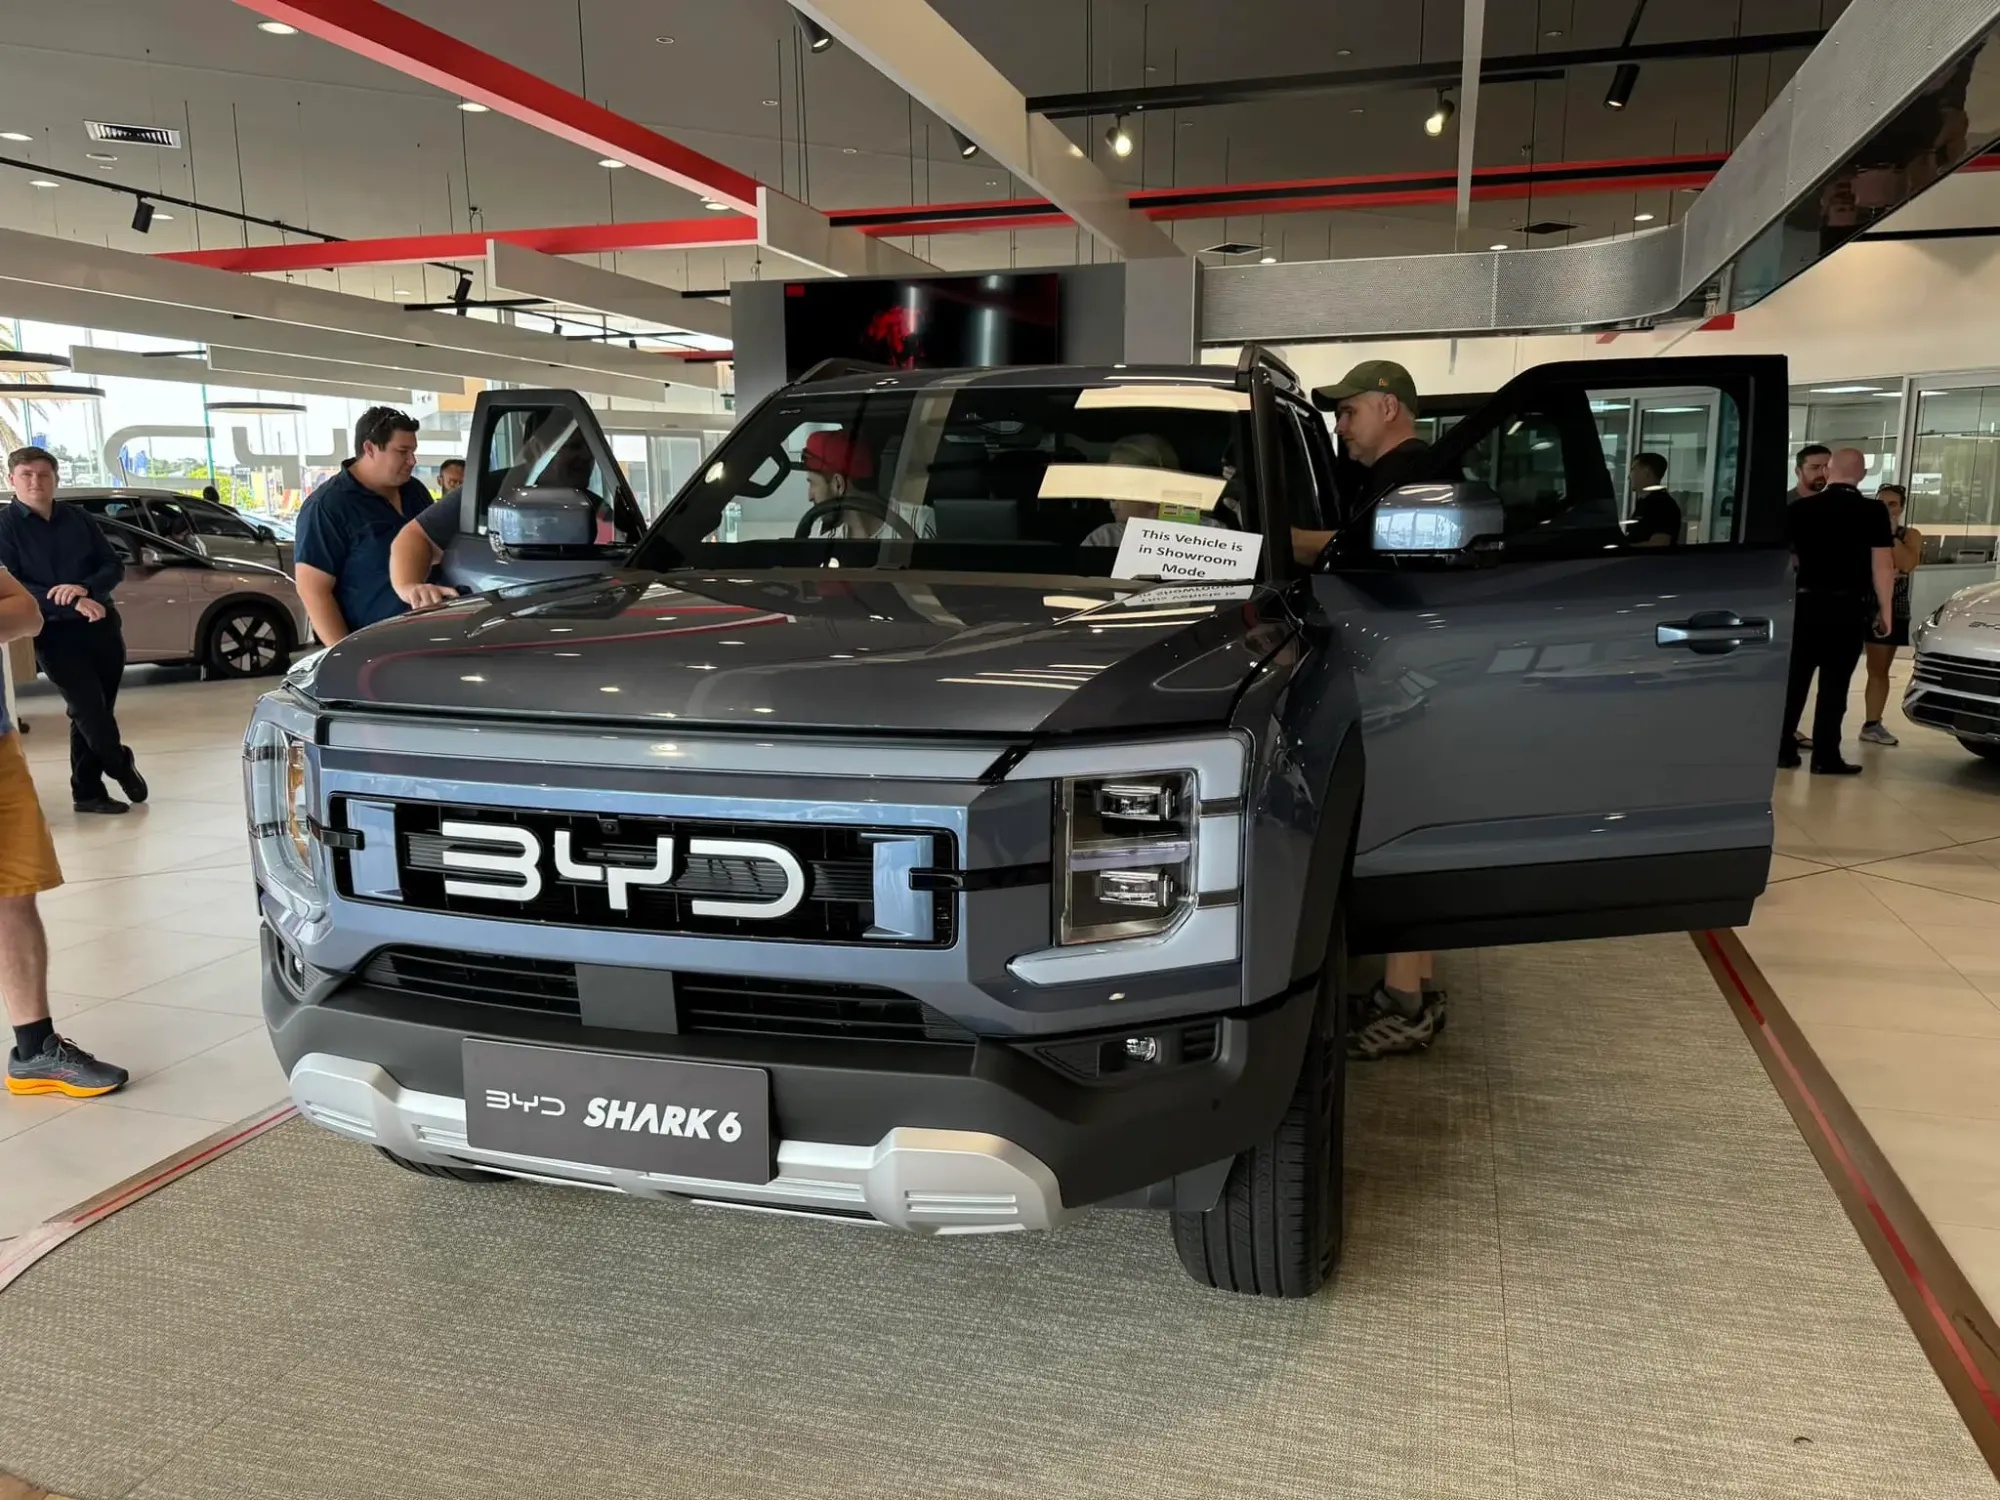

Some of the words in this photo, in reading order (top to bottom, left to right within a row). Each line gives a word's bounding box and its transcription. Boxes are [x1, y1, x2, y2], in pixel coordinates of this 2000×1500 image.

[1141, 529, 1170, 541] This
[1175, 533, 1228, 550] Vehicle
[1231, 542, 1243, 552] is
[1138, 544, 1152, 554] in
[1156, 546, 1238, 567] Showroom
[1162, 563, 1206, 578] Mode
[442, 820, 805, 919] BYD
[485, 1089, 566, 1116] BYD
[582, 1097, 718, 1140] SHARK
[717, 1111, 742, 1143] 6
